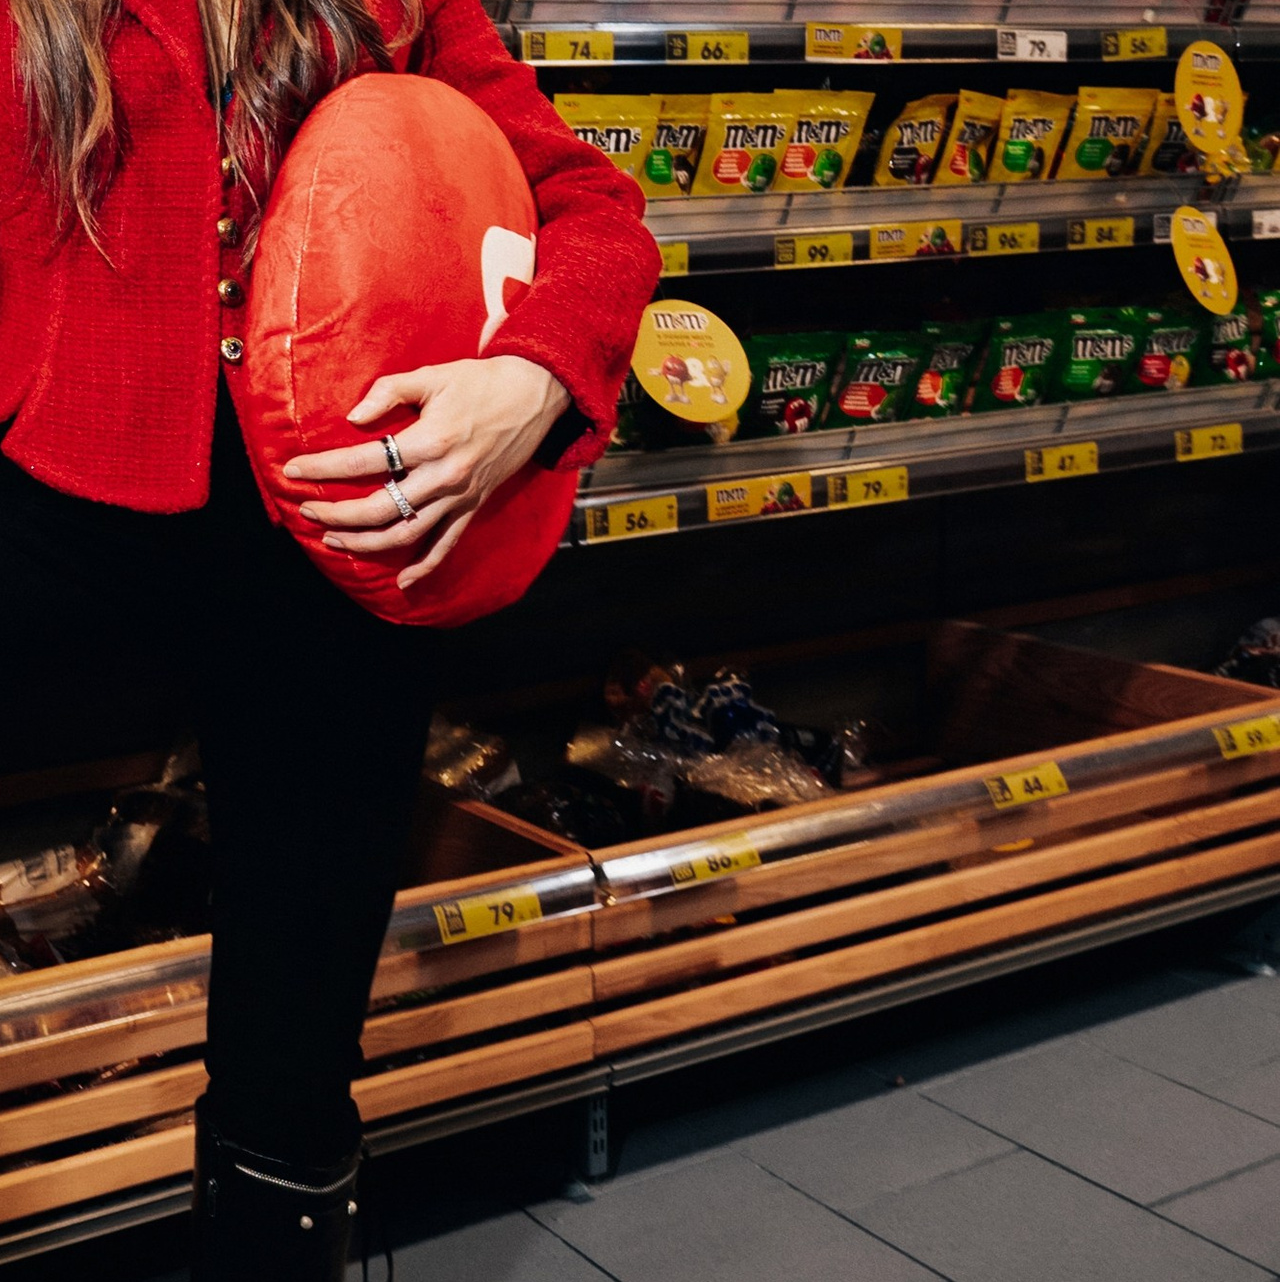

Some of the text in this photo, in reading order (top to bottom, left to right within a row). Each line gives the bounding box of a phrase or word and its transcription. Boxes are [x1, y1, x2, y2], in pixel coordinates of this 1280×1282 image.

[569, 42, 591, 60] 74
[701, 42, 723, 59] 66
[808, 245, 829, 261] 99
[863, 481, 882, 498] 79
[625, 513, 648, 531] 56
[488, 901, 514, 926] 79
